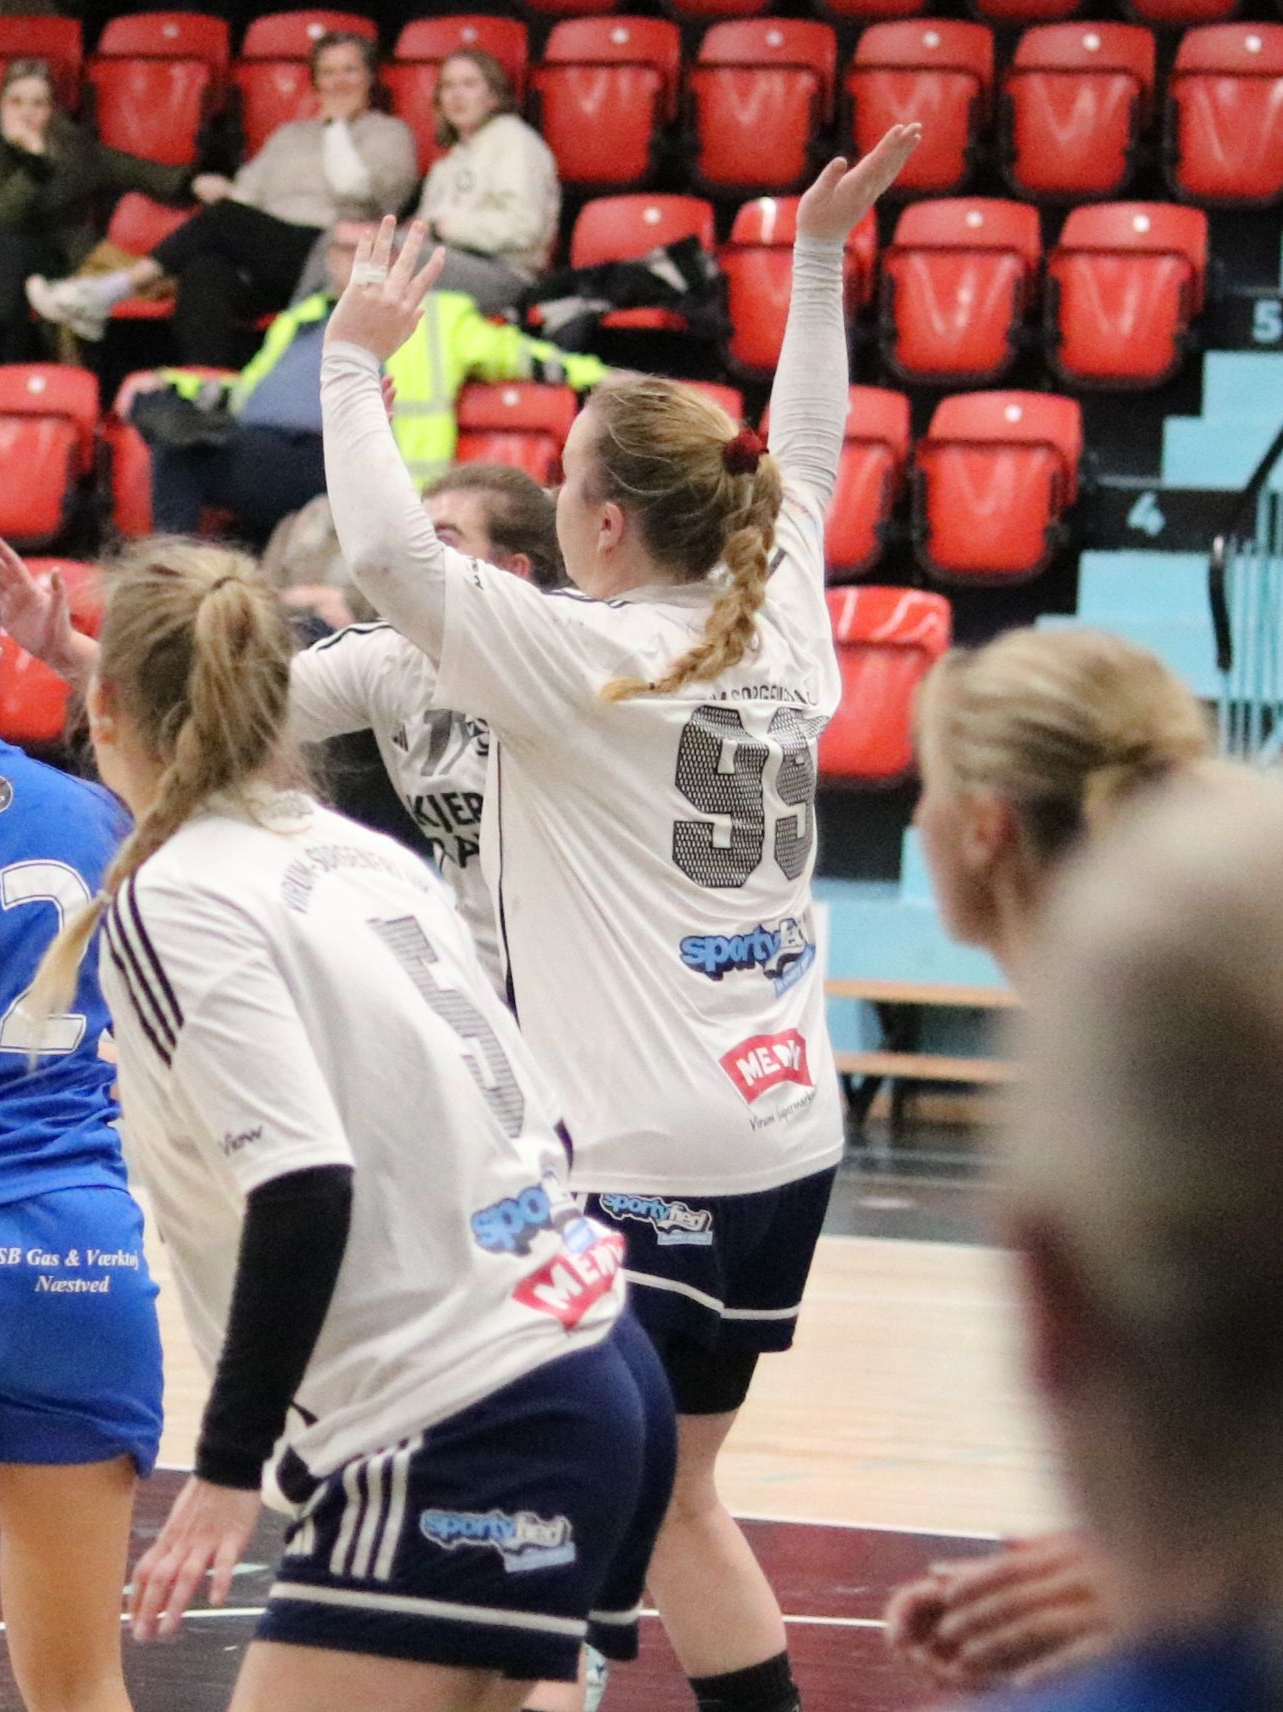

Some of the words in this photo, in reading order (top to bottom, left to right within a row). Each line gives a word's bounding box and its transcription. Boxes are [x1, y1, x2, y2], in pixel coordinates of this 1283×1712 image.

[1252, 300, 1282, 343] 5
[1126, 491, 1166, 537] 4
[25, 1248, 60, 1267] Gas
[64, 1249, 80, 1267] &
[34, 1275, 110, 1294] Næstved
